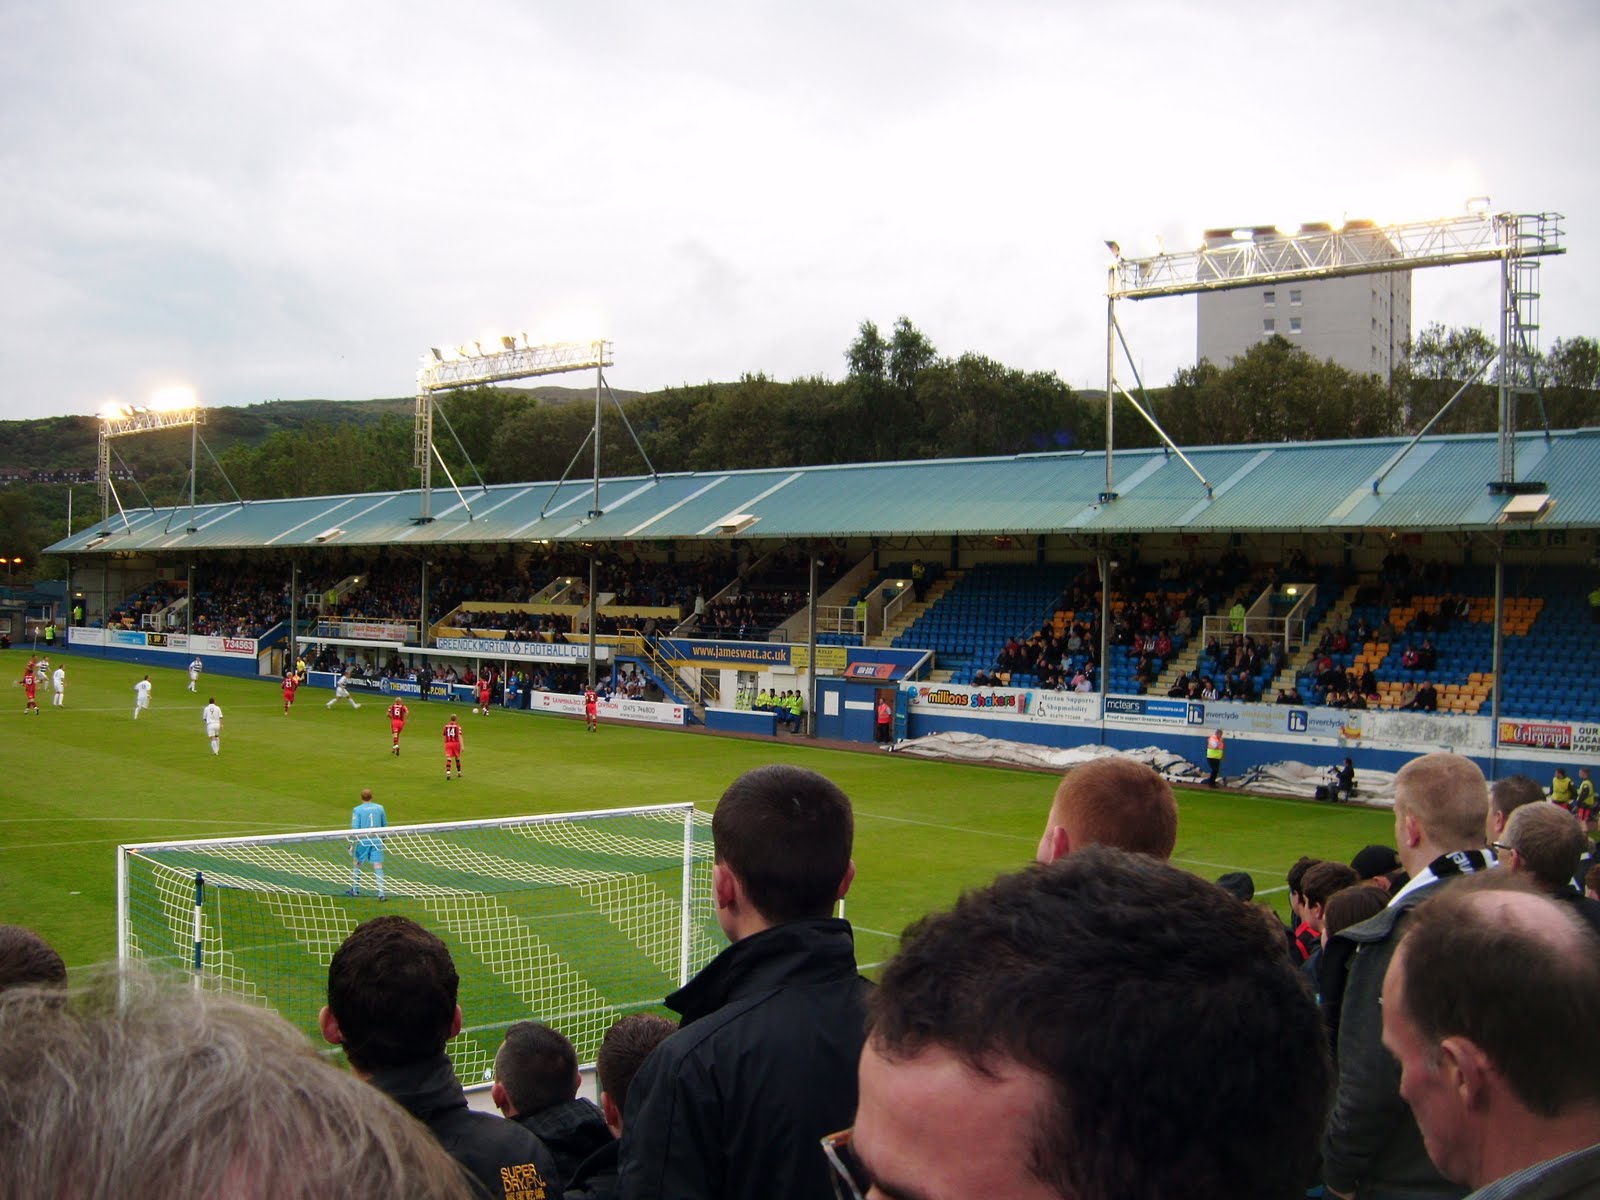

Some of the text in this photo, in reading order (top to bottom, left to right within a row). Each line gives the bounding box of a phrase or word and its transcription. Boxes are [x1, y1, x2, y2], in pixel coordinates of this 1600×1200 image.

[225, 639, 253, 650] 734563
[438, 638, 589, 658] GREENOCK MORTON FOOTBALL CLU
[692, 645, 787, 662] www.jameswatt.ac.uk
[928, 689, 968, 706] millions
[970, 693, 1016, 708] Shakers
[1041, 694, 1095, 704] Morton Supports
[1107, 699, 1140, 710] mctears
[209, 707, 215, 716] 9
[394, 707, 400, 716] 6
[446, 727, 456, 738] 14
[1513, 723, 1570, 748] Telegraph
[1578, 727, 1599, 735] OUR
[368, 813, 374, 827] 1
[500, 1163, 537, 1180] SUPER
